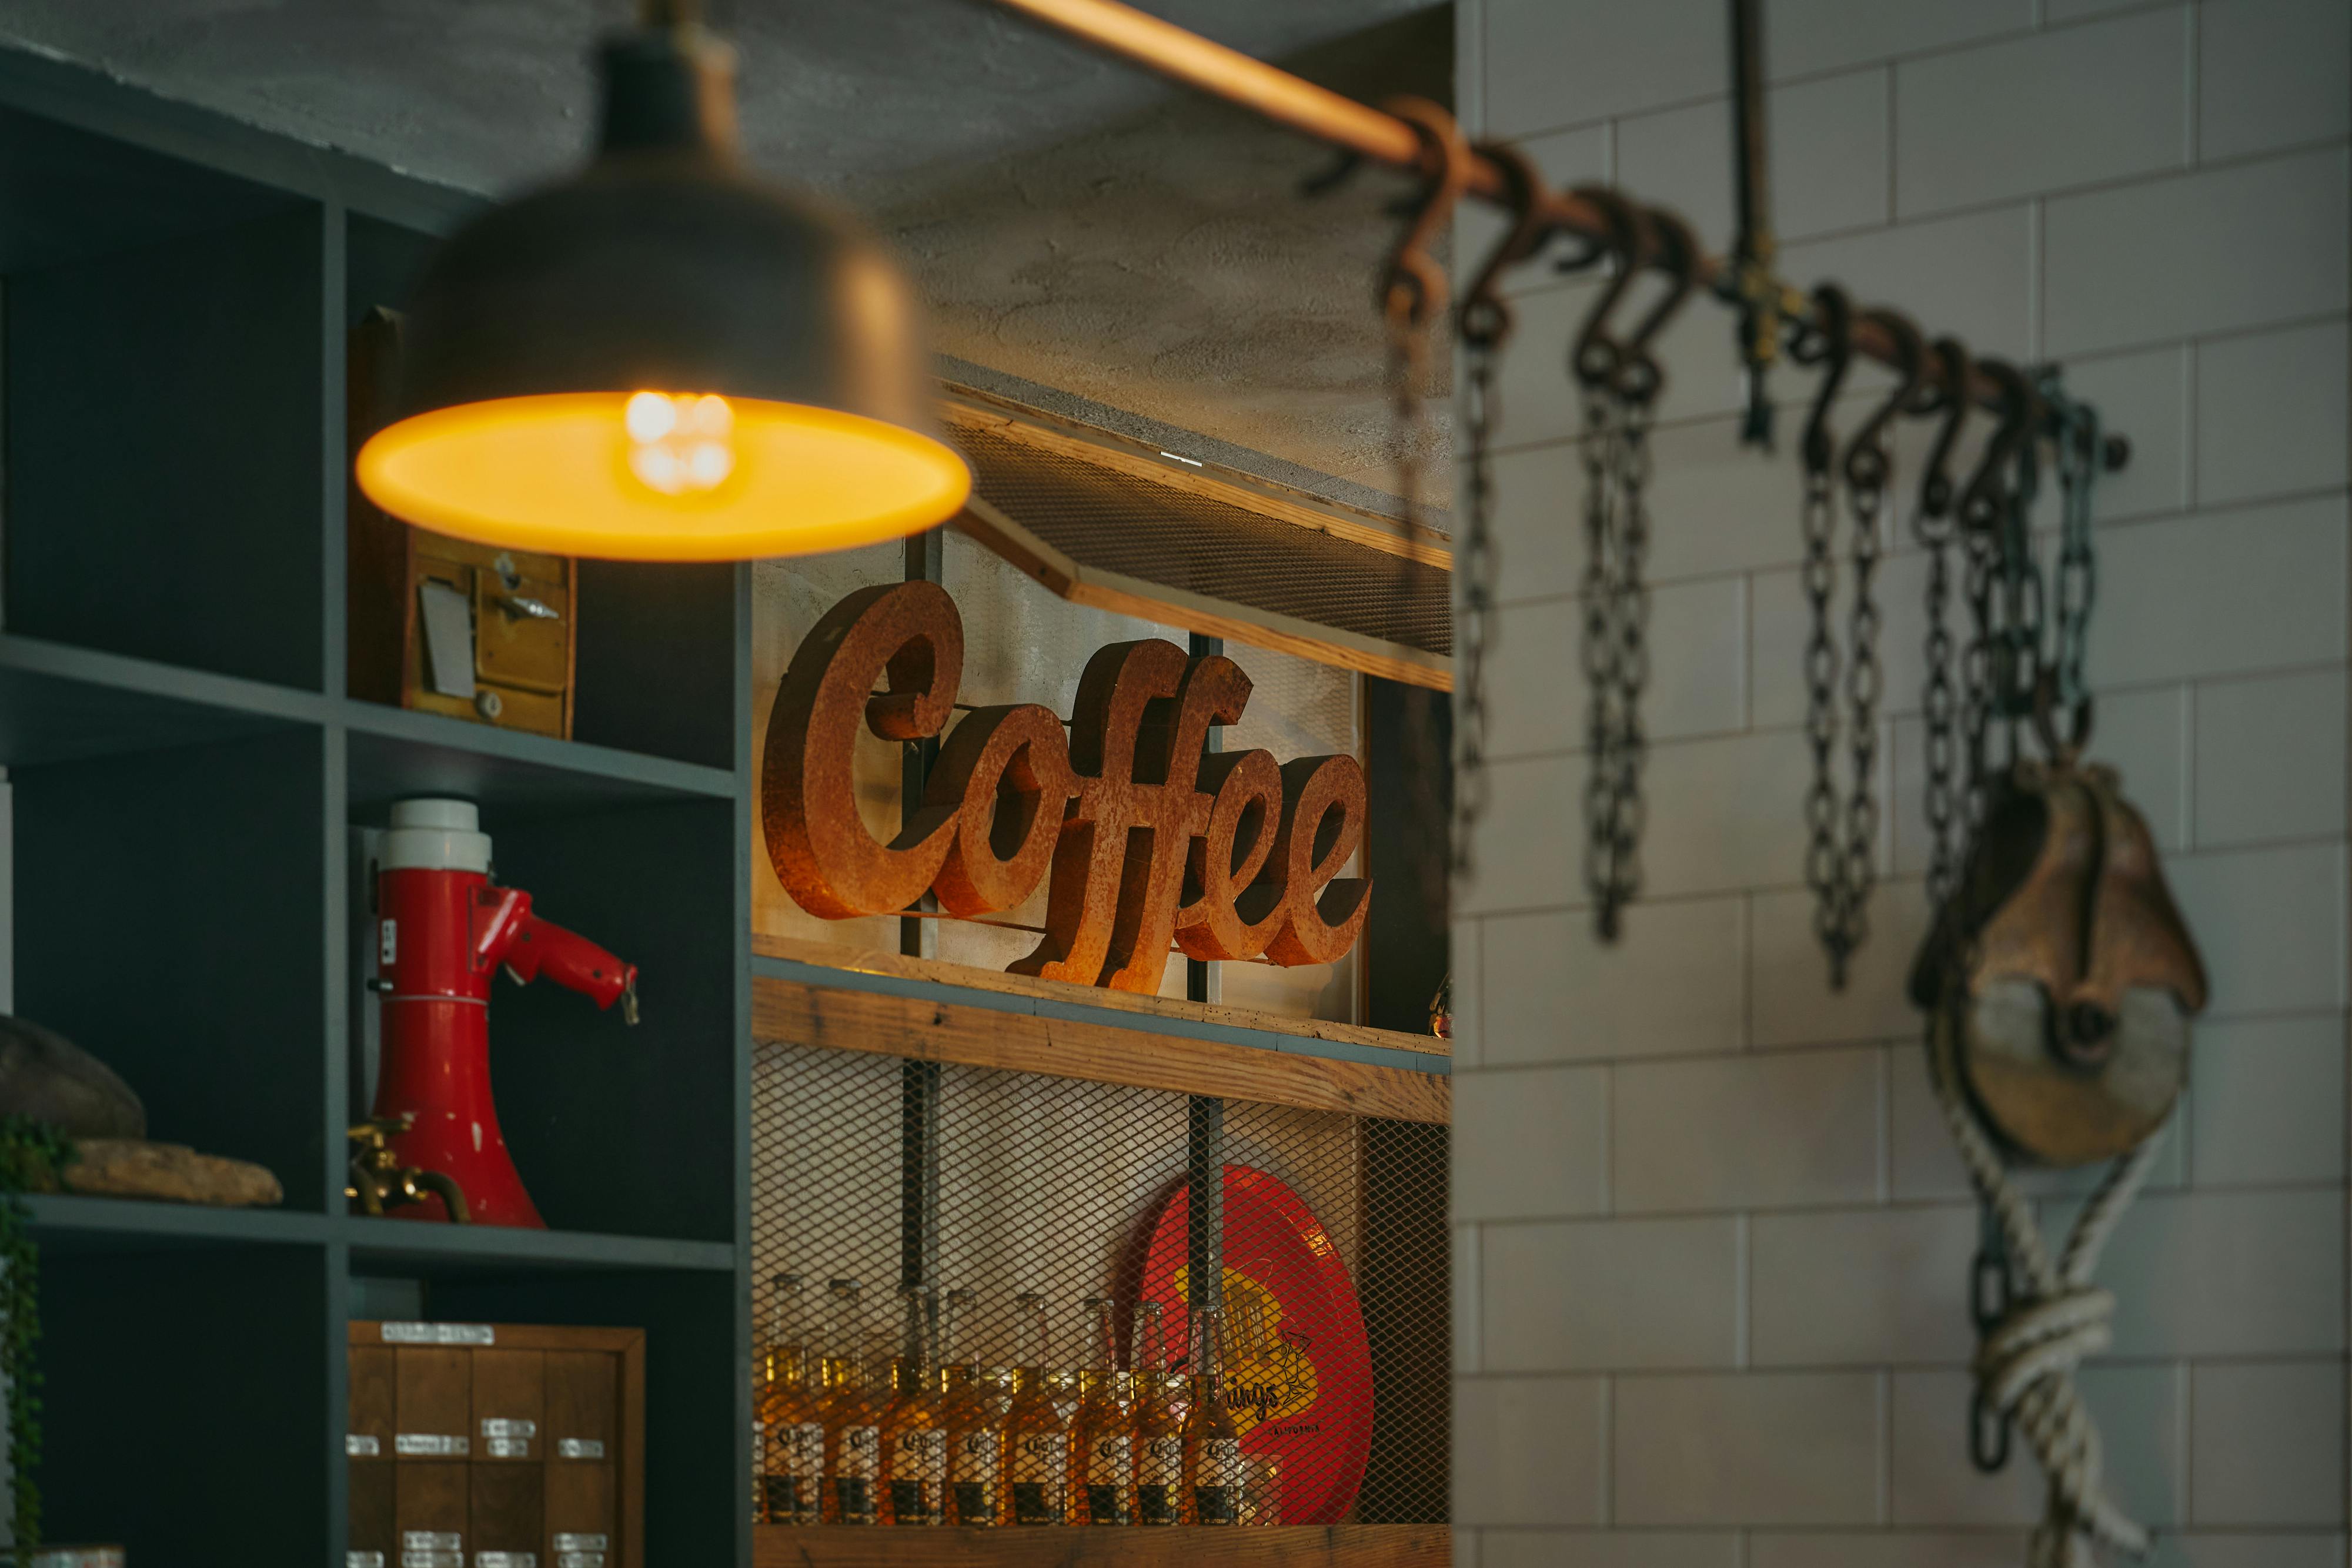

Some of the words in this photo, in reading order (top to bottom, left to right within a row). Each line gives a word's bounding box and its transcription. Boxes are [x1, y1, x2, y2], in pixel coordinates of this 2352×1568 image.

[763, 580, 1373, 995] Coffee
[1227, 1376, 1278, 1422] ings
[1268, 1424, 1319, 1436] ALIFORNIA
